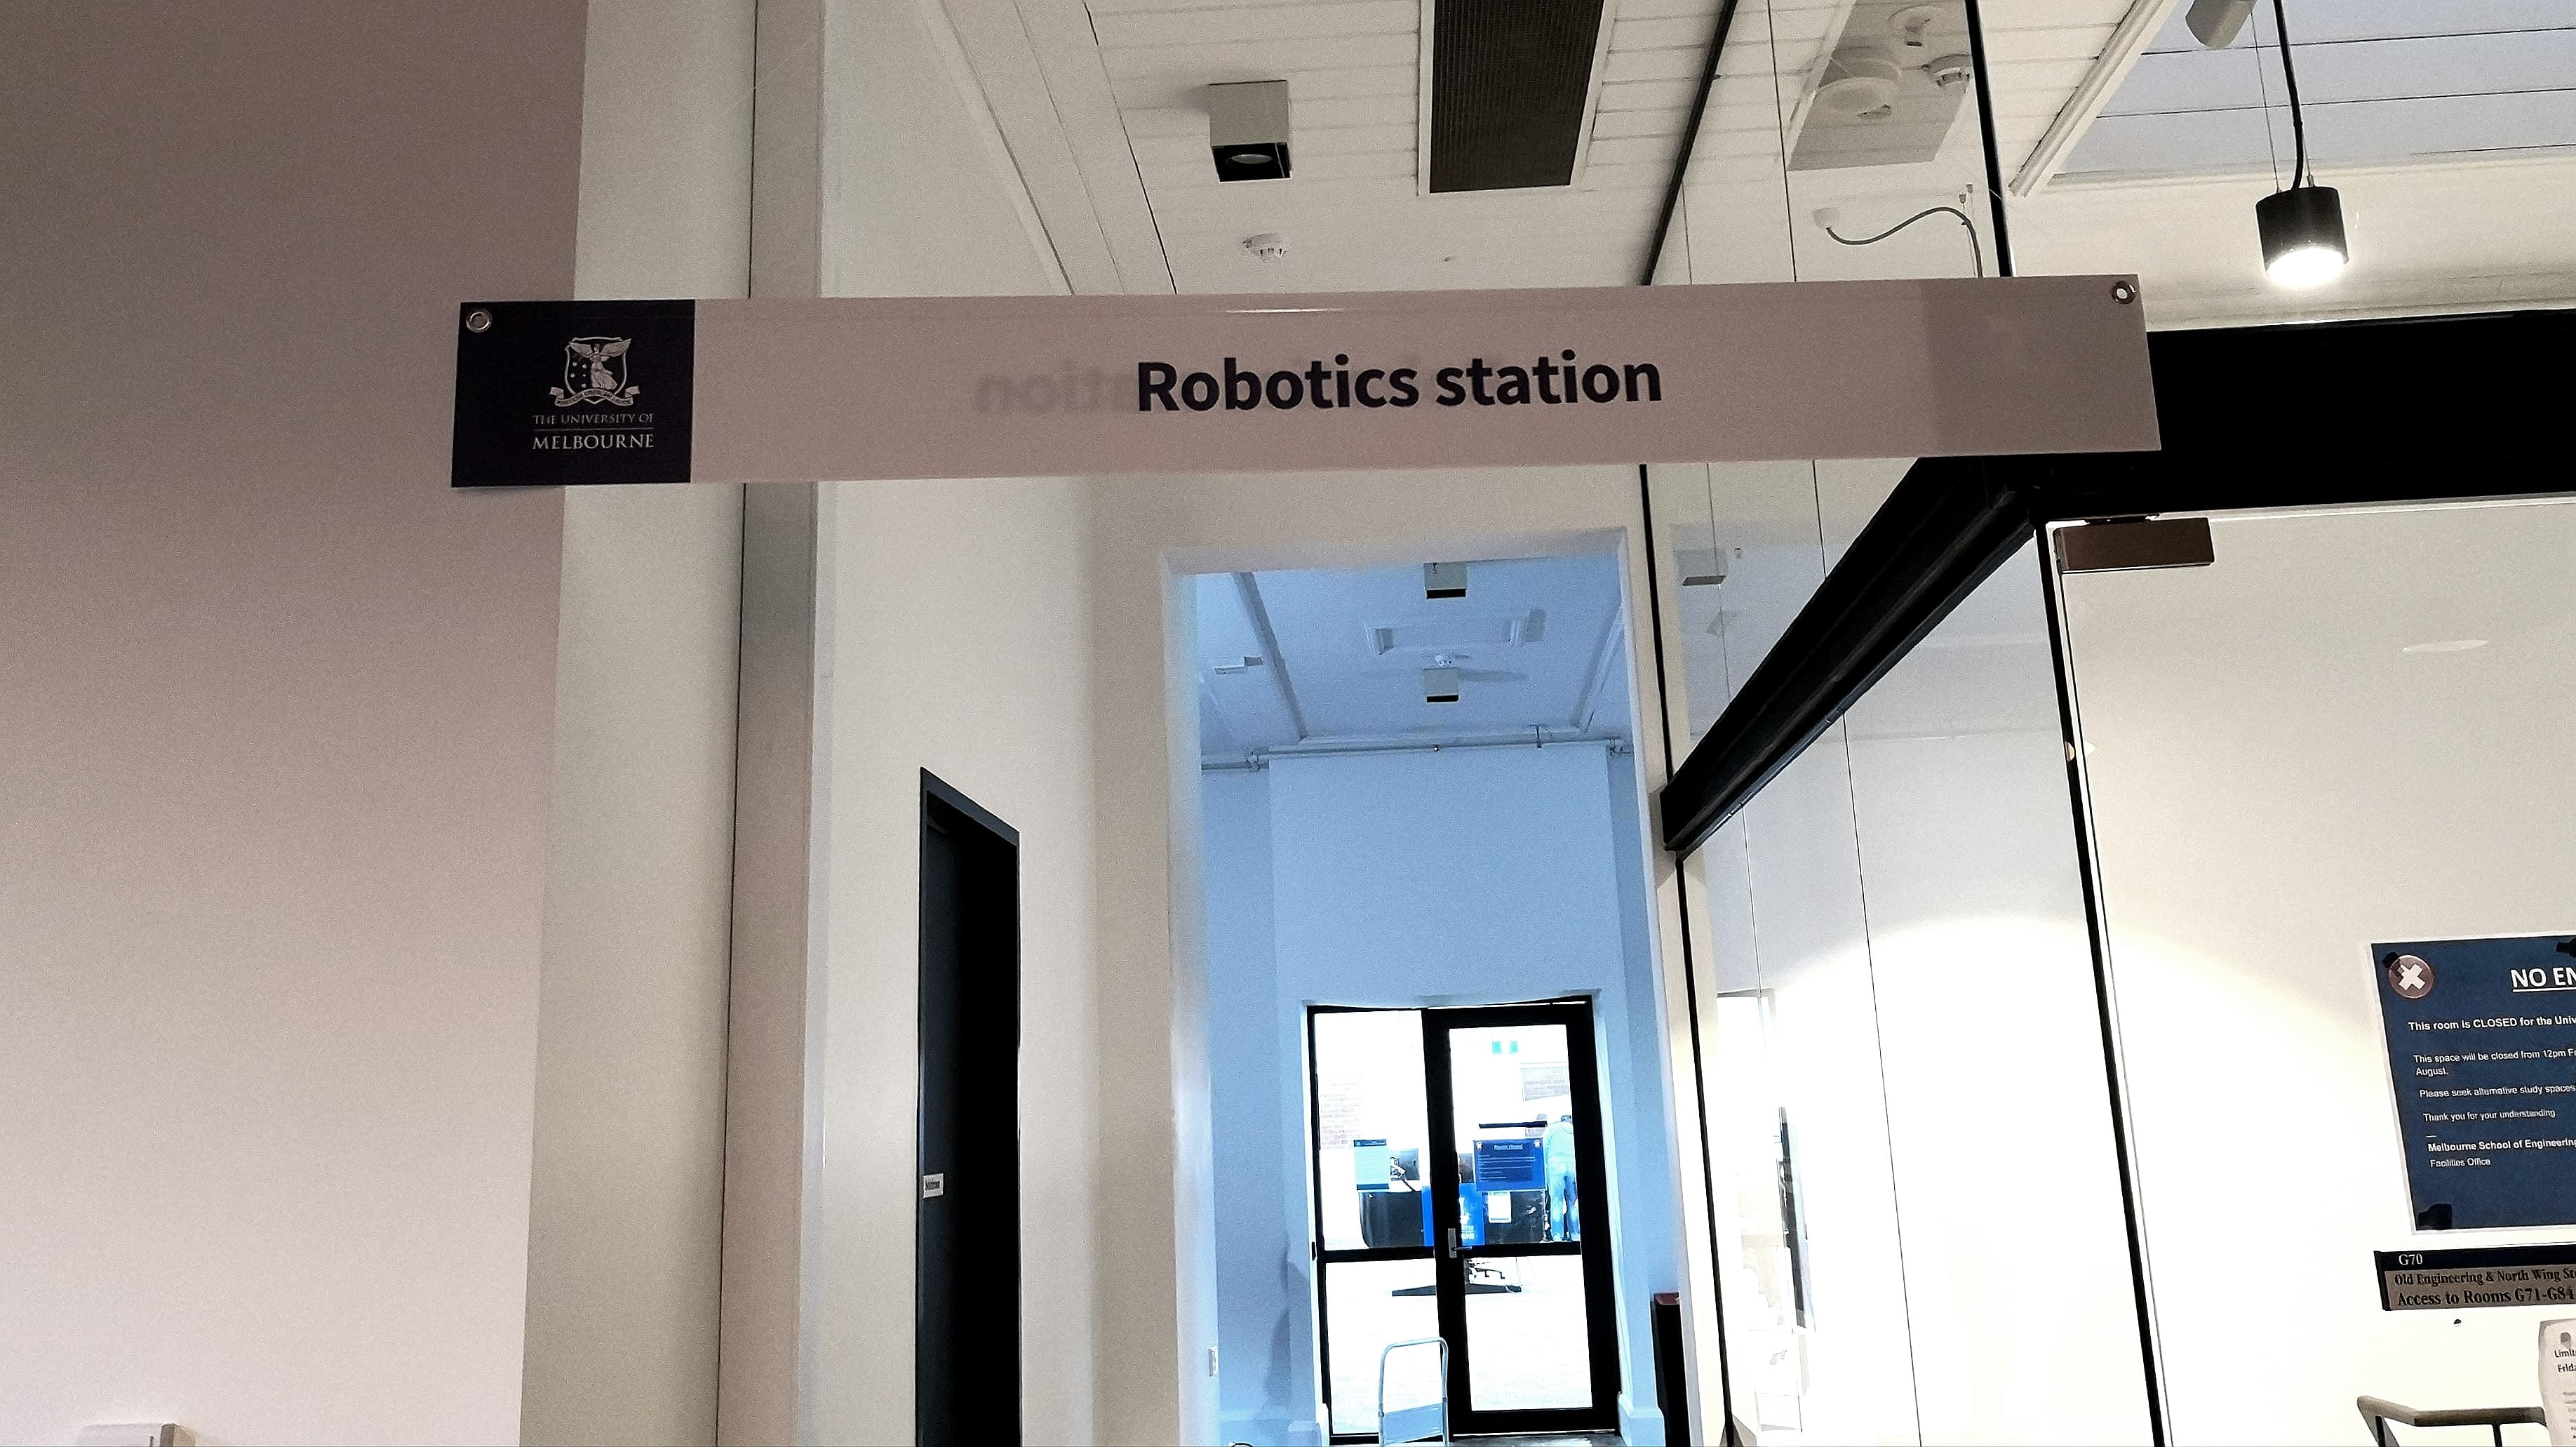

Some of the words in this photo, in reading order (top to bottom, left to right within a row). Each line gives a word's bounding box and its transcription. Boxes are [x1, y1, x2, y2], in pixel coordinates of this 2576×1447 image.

[1139, 353, 1420, 412] Robotics
[1435, 349, 1663, 406] station
[532, 414, 556, 425] THE
[561, 413, 635, 424] UNIVERSITY
[639, 413, 656, 423] OF
[532, 434, 655, 450] MELBOURNE
[2510, 968, 2547, 988] NO
[2408, 1021, 2431, 1031] This
[2433, 1022, 2459, 1030] room
[2462, 1020, 2471, 1029] is
[2473, 1018, 2518, 1029] CLOSED
[2519, 1016, 2535, 1027] for
[2536, 1015, 2553, 1025] the
[2413, 1054, 2433, 1063] This
[2434, 1055, 2460, 1064] space
[2462, 1052, 2476, 1062] will
[2478, 1052, 2489, 1061] be
[2490, 1051, 2518, 1060] closed
[2521, 1050, 2540, 1059] from
[2542, 1048, 2566, 1059] 12pm
[2415, 1067, 2449, 1077] August.
[2419, 1088, 2450, 1098] Please
[2451, 1087, 2473, 1097] seek
[2474, 1086, 2518, 1096] alternative
[2519, 1085, 2543, 1095] study
[2423, 1111, 2449, 1122] Thank
[2450, 1113, 2466, 1123] you
[2467, 1111, 2478, 1121] for
[2480, 1112, 2498, 1121] your
[2428, 1142, 2477, 1152] Melbourne
[2478, 1140, 2511, 1151] School
[2514, 1140, 2523, 1149] of
[2430, 1158, 2466, 1168] Facilities
[2467, 1157, 2491, 1167] Office
[2399, 1253, 2423, 1266] G70
[2394, 1273, 2414, 1286] Old
[2417, 1271, 2484, 1288] Engineering
[2486, 1271, 2495, 1282] &
[2497, 1269, 2530, 1282] North
[2531, 1269, 2561, 1283] Wing
[2399, 1292, 2442, 1306] Access
[2445, 1291, 2460, 1305] to
[2463, 1290, 2511, 1304] Rooms
